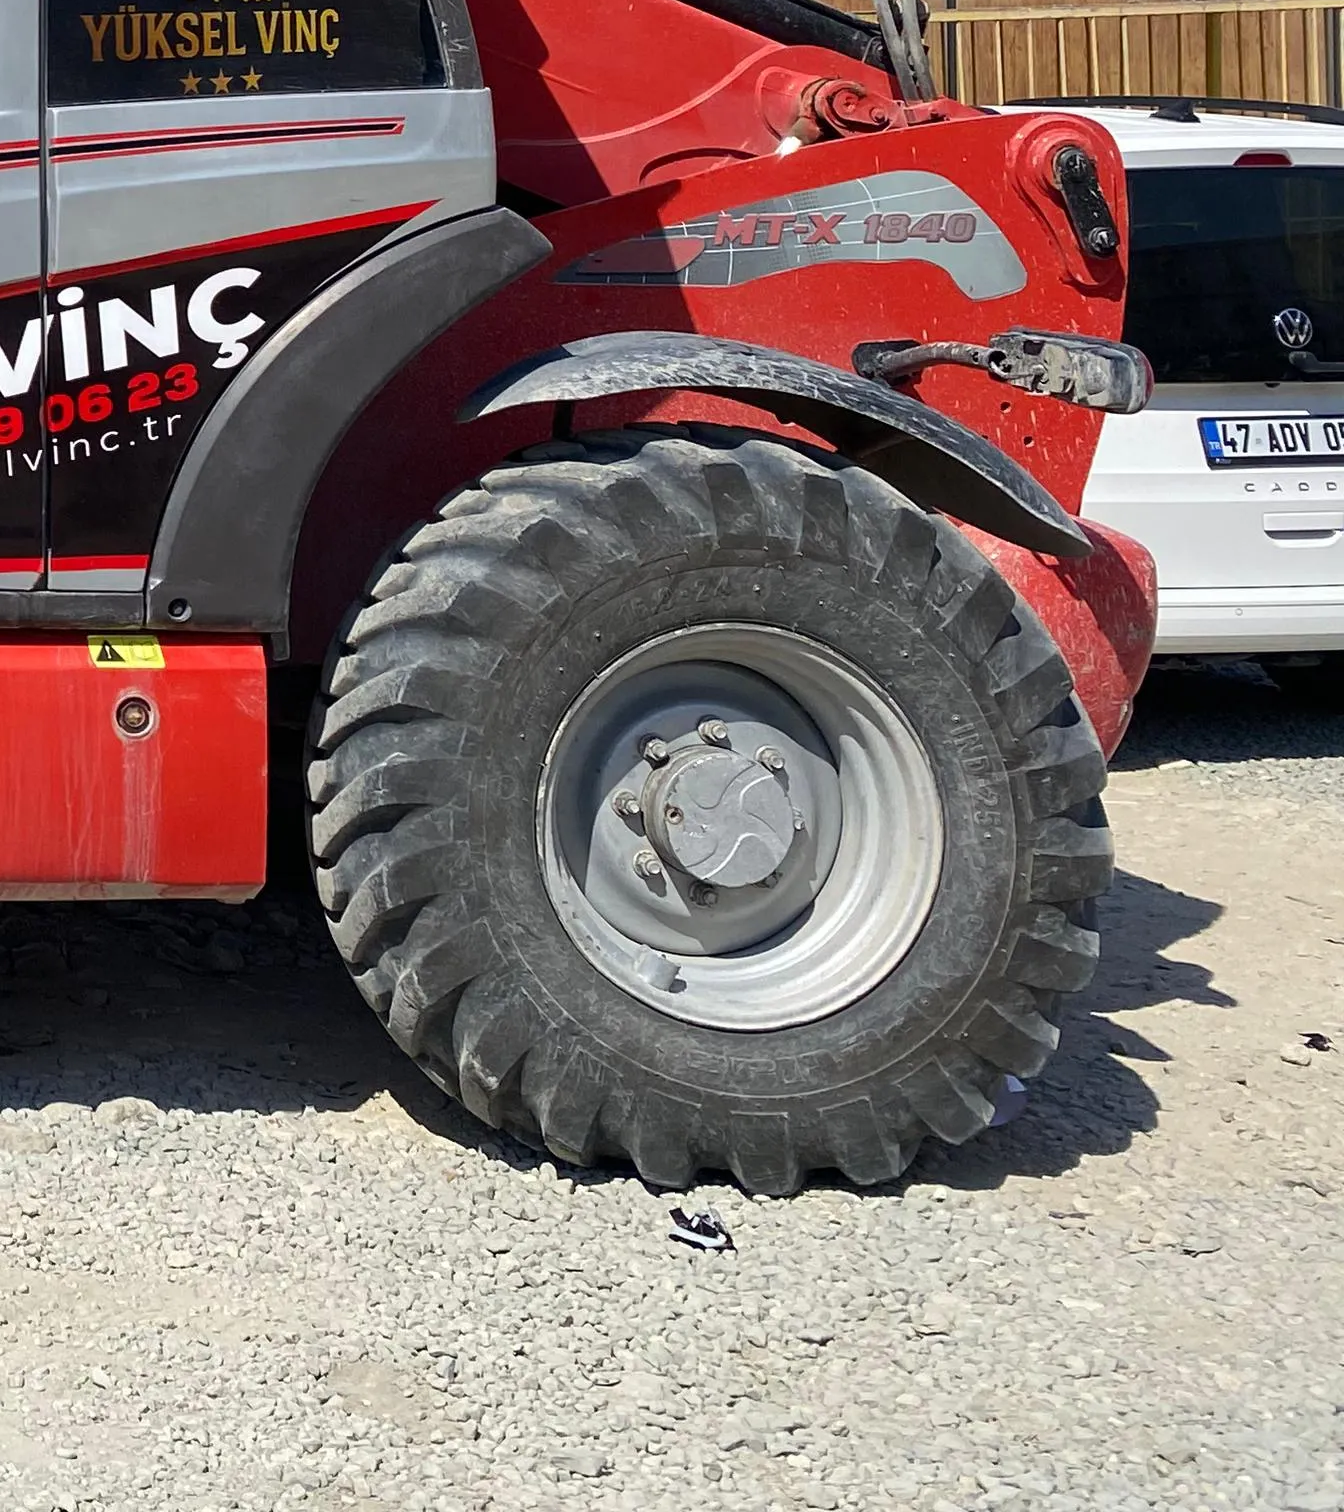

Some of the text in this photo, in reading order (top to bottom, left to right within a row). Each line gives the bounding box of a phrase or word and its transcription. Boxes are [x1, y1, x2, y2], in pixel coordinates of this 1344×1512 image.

[80, 2, 340, 62] YÜKSEL VİNÇ
[714, 211, 977, 246] MT-X 1840
[46, 383, 115, 434] 06
[126, 362, 200, 413] 23
[1221, 423, 1250, 453] 47
[1267, 422, 1311, 453] ADV
